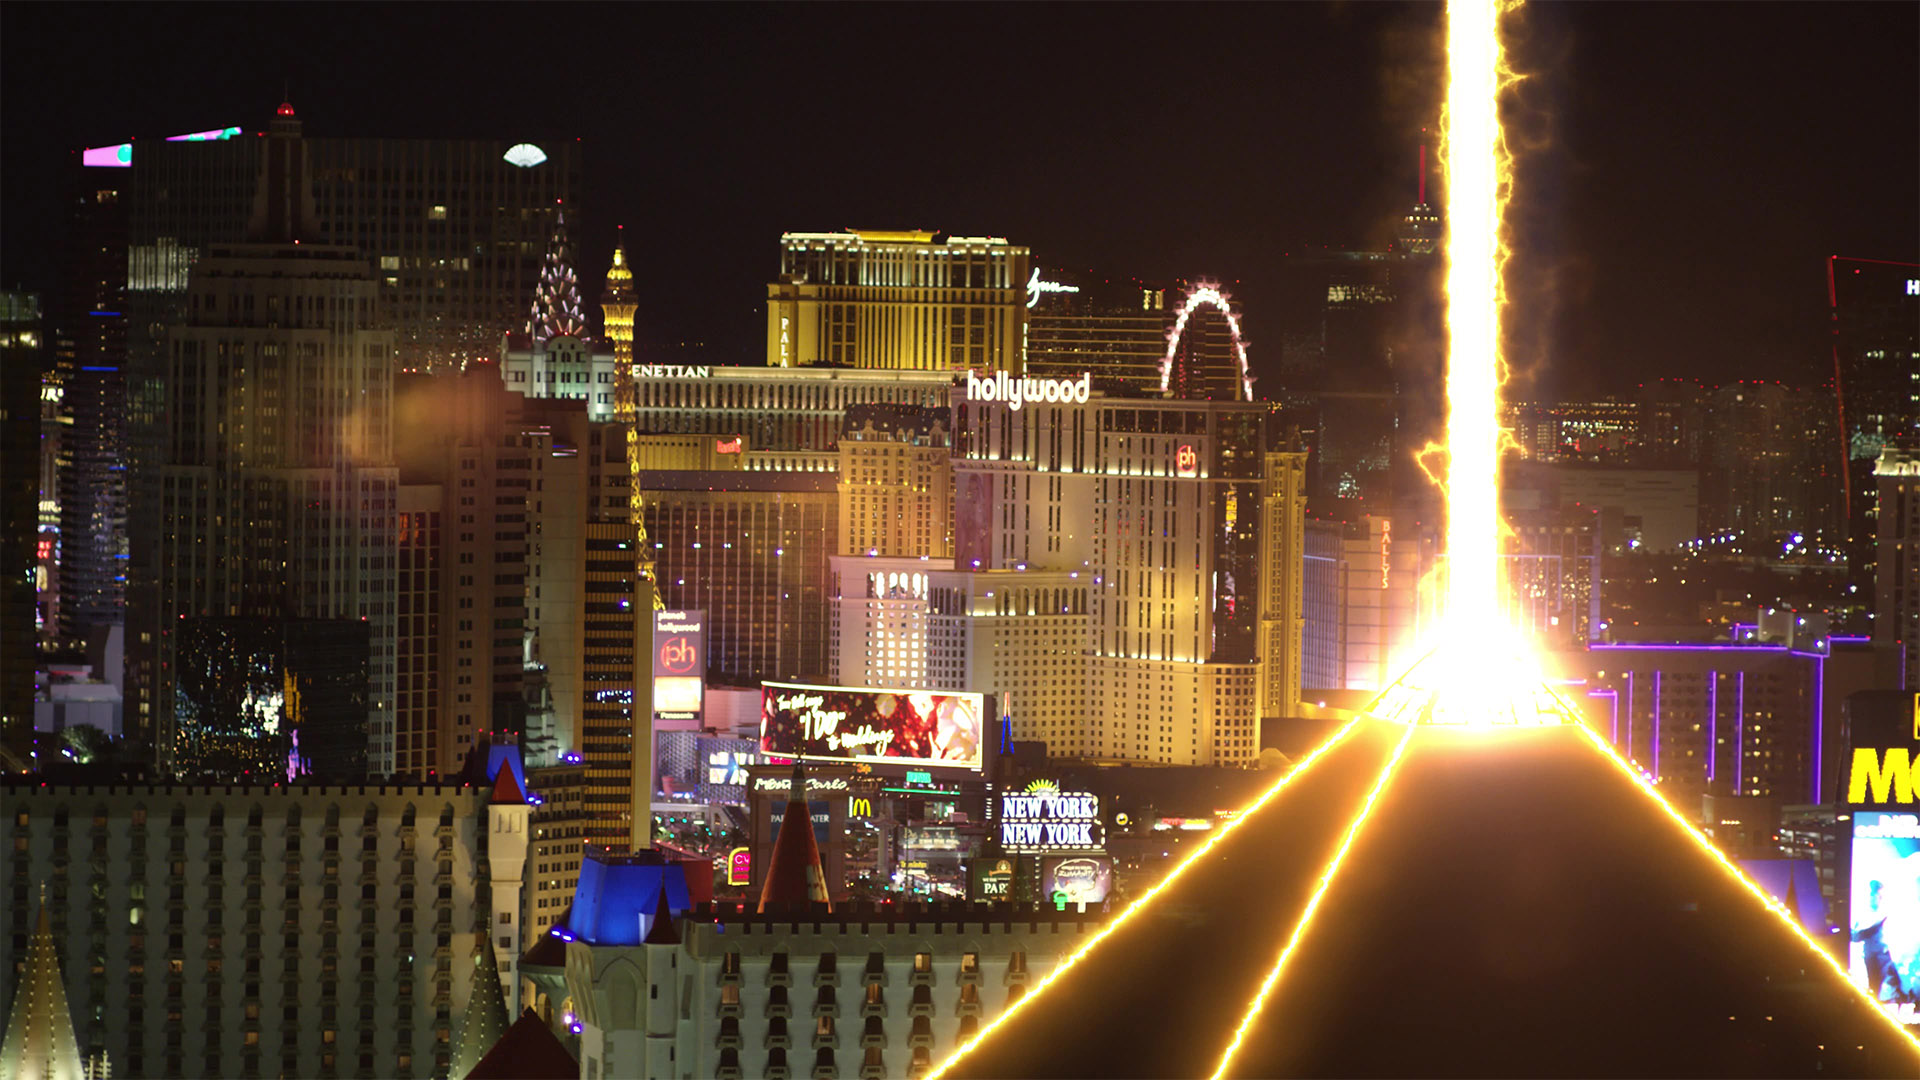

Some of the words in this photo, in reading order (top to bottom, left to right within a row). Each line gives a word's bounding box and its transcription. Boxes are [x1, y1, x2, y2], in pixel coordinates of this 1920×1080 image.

[1907, 280, 1920, 295] H
[781, 317, 789, 368] PALA
[632, 365, 709, 377] ENETIAN
[967, 369, 1090, 411] hollywood
[1178, 446, 1196, 466] ph
[1382, 520, 1391, 589] BALLYS
[657, 622, 700, 633] hollywood
[663, 637, 696, 669] ph
[754, 778, 791, 791] Mont
[1848, 748, 1920, 803] M
[1003, 797, 1041, 818] NEW
[1045, 797, 1093, 818] YORK
[1002, 824, 1043, 844] NEW
[1045, 824, 1093, 844] YORK
[734, 854, 750, 865] CV
[984, 882, 1009, 894] PAR
